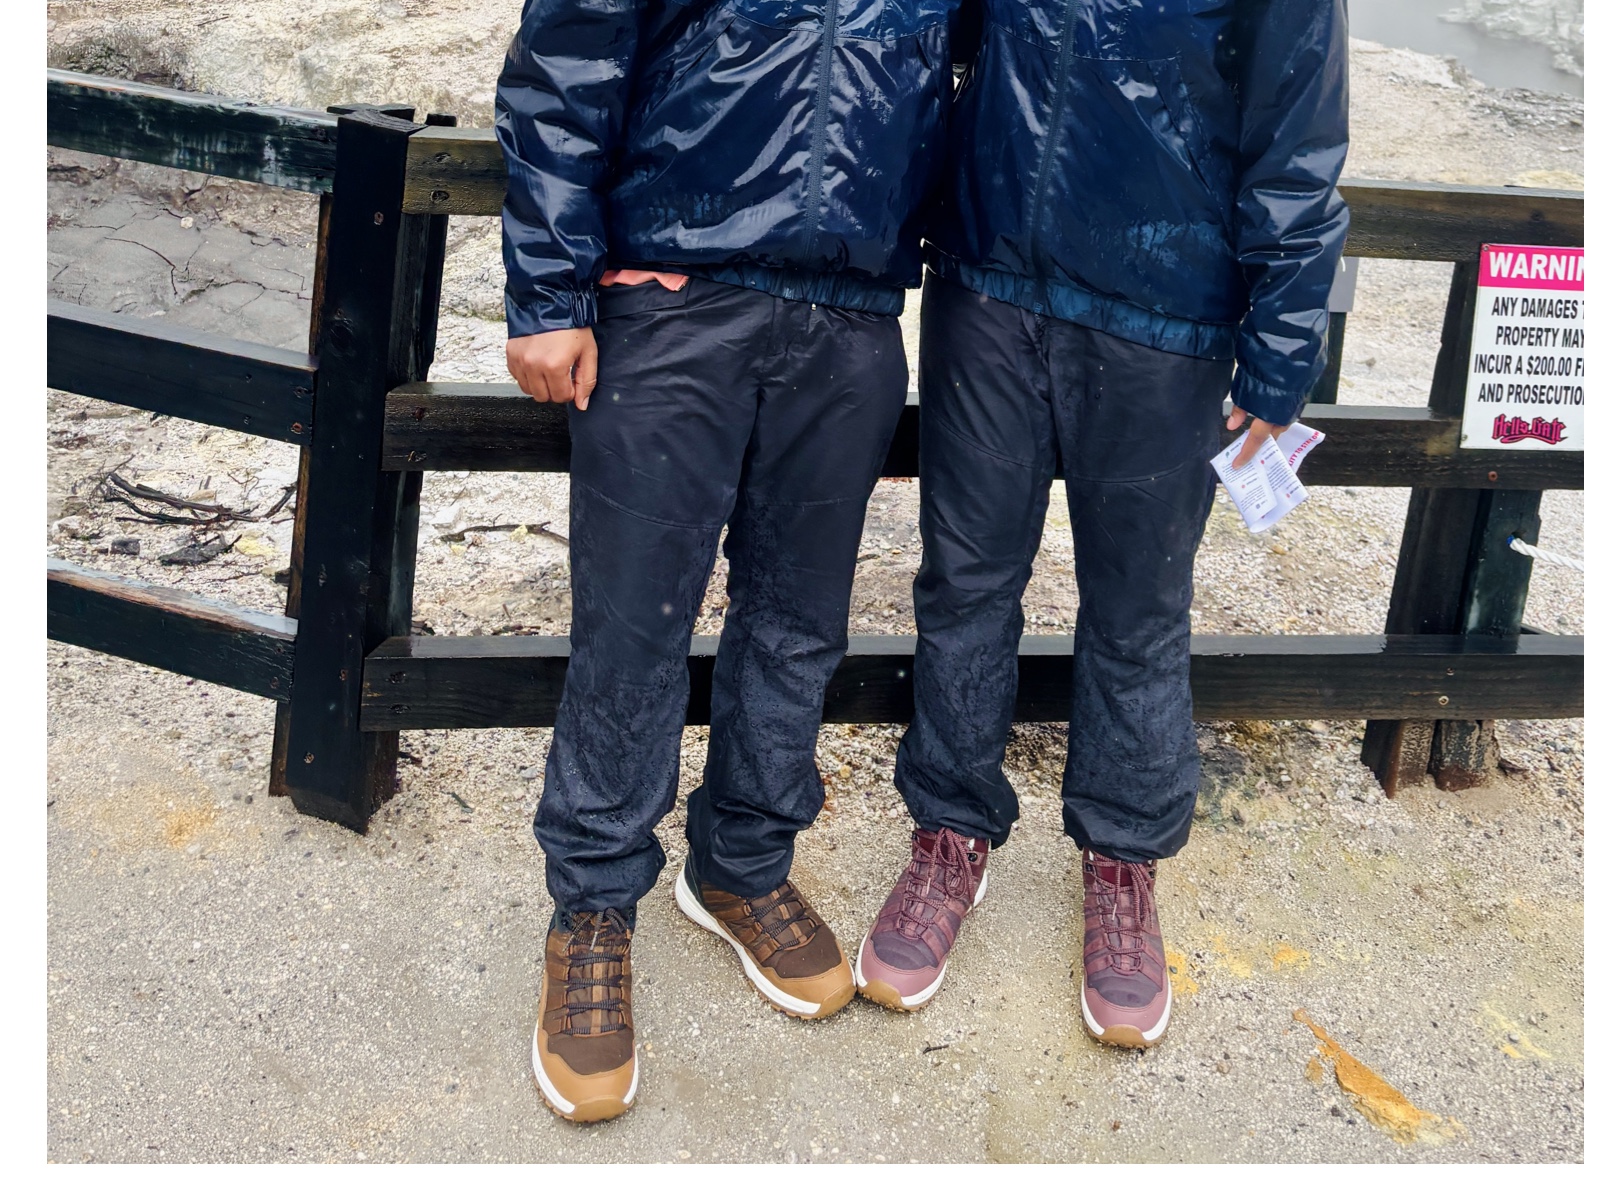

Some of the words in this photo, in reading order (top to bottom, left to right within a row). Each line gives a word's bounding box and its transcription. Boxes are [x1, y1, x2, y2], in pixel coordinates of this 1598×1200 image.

[1491, 296, 1518, 317] ANY
[1520, 297, 1579, 320] DAMAGES
[1495, 325, 1560, 348] PROPERTY
[1474, 353, 1512, 374] INCUR
[1514, 355, 1523, 375] A
[1526, 355, 1572, 377] $200.00
[1477, 383, 1504, 403] AND
[1506, 384, 1584, 406] PROSECUTIO
